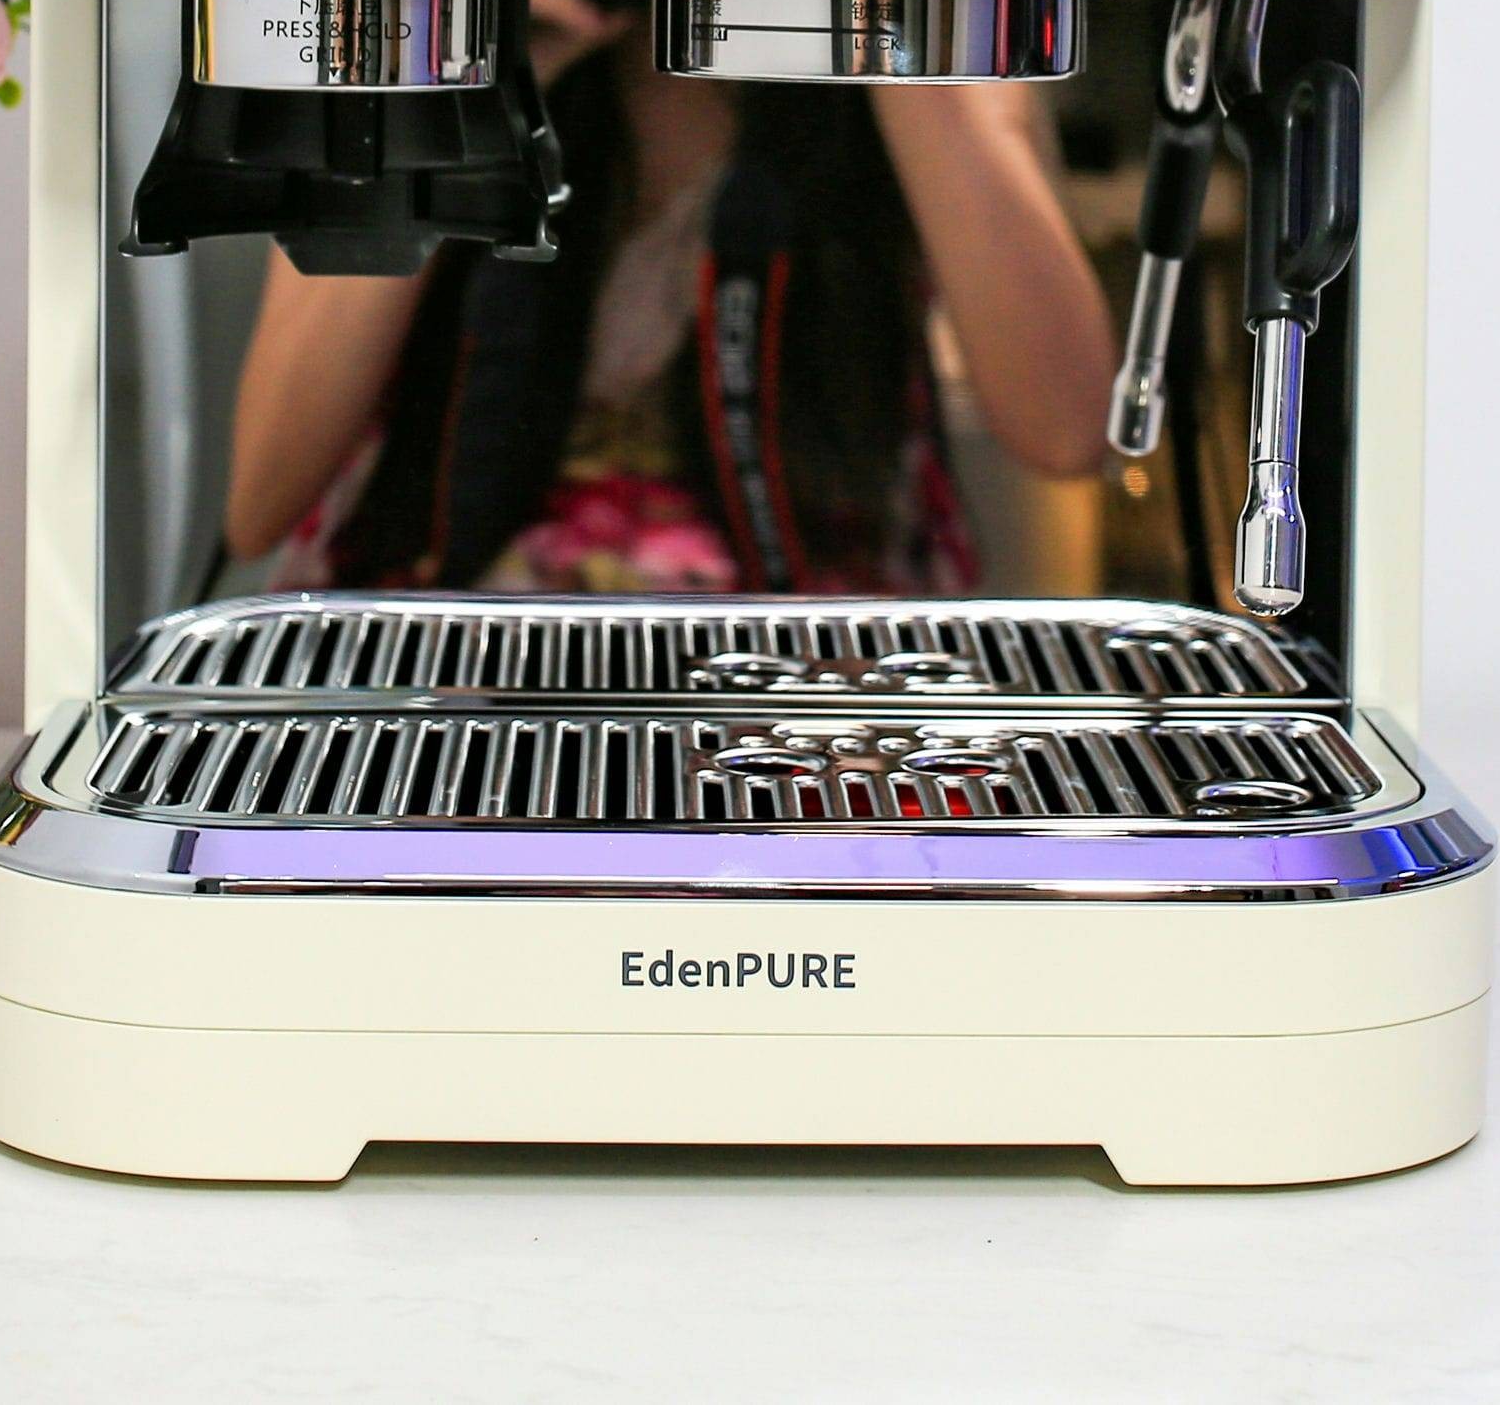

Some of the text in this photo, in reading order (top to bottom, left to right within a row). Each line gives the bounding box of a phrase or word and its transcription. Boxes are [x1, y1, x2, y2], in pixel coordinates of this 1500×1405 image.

[263, 20, 412, 40] PRESS&OLD
[854, 37, 901, 51] LOCK
[299, 45, 372, 64] GIND
[621, 949, 856, 989] EdenPURE
